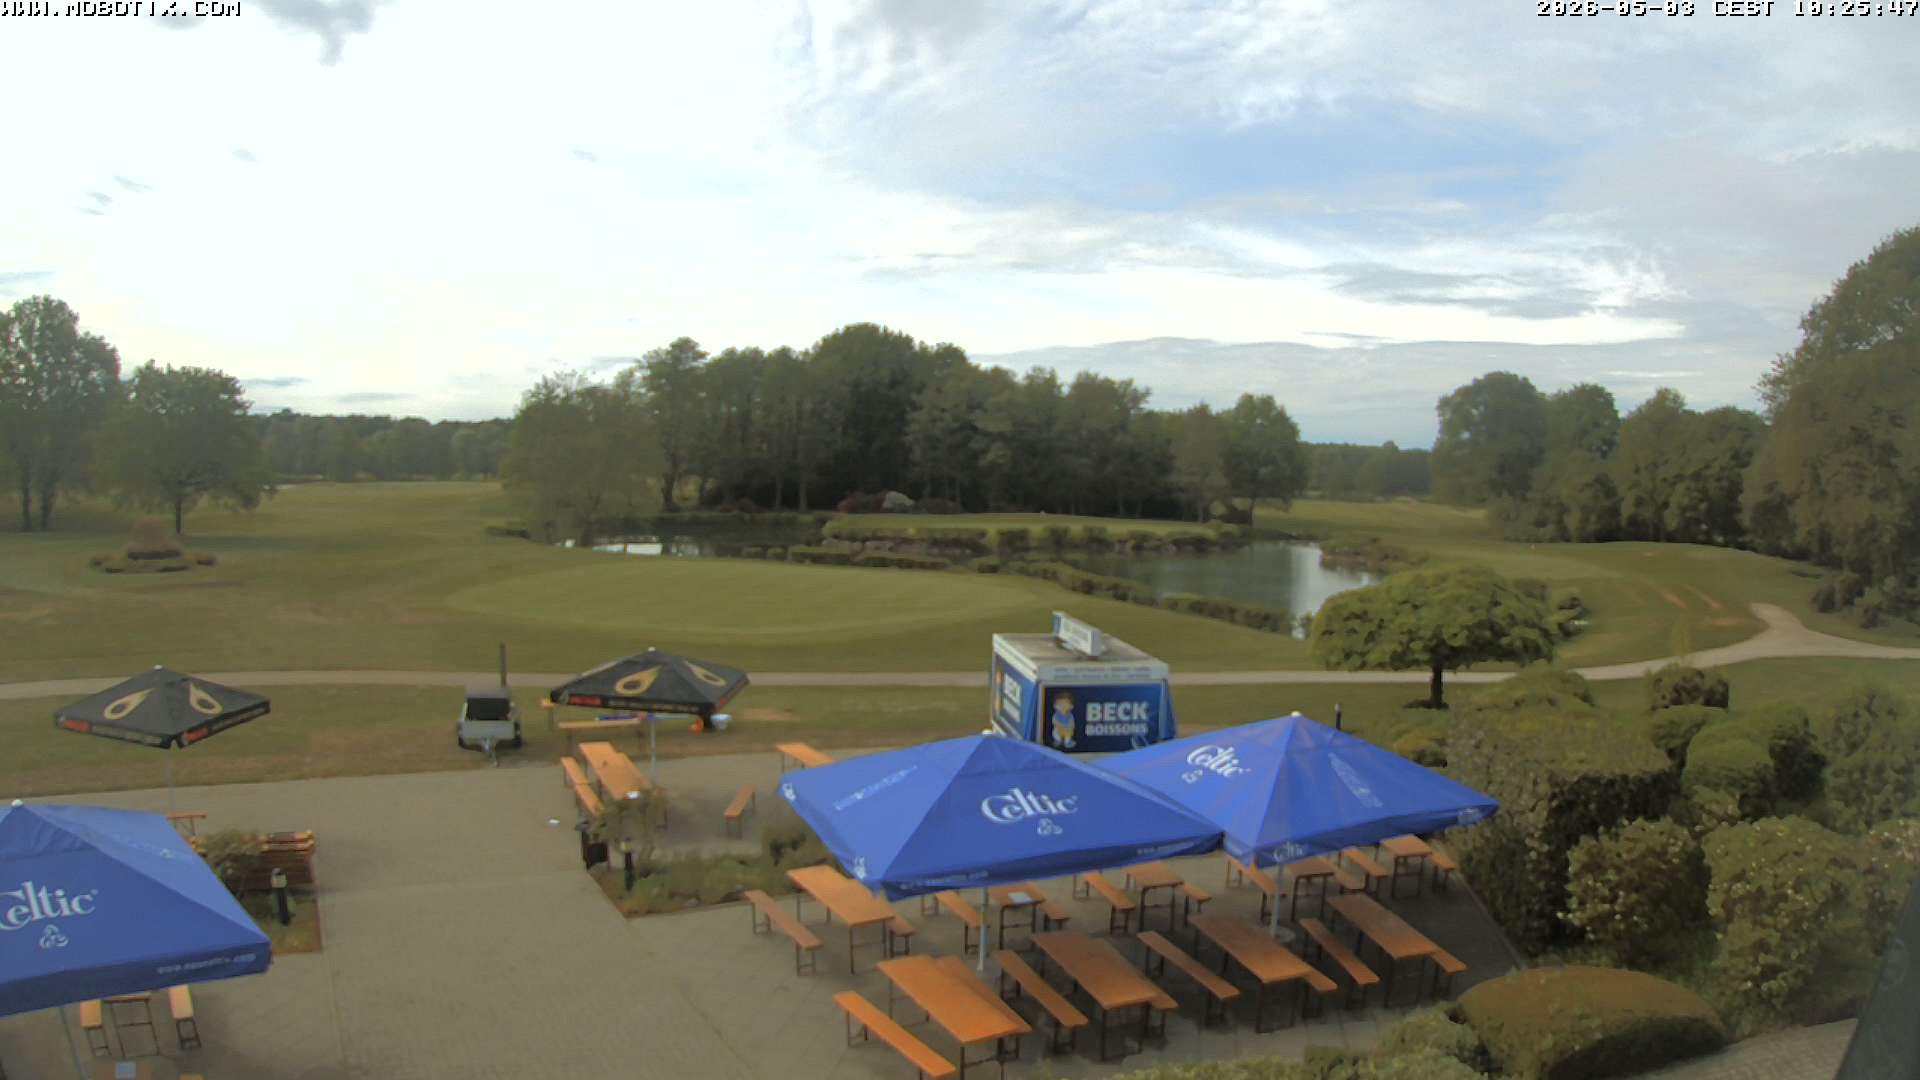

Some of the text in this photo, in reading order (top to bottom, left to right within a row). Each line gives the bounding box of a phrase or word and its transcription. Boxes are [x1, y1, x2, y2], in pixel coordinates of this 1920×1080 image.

[1086, 702, 1149, 721] BECK
[1085, 723, 1149, 736] BOISSONS
[1186, 744, 1245, 777] Celtic
[980, 787, 1077, 823] Celtic
